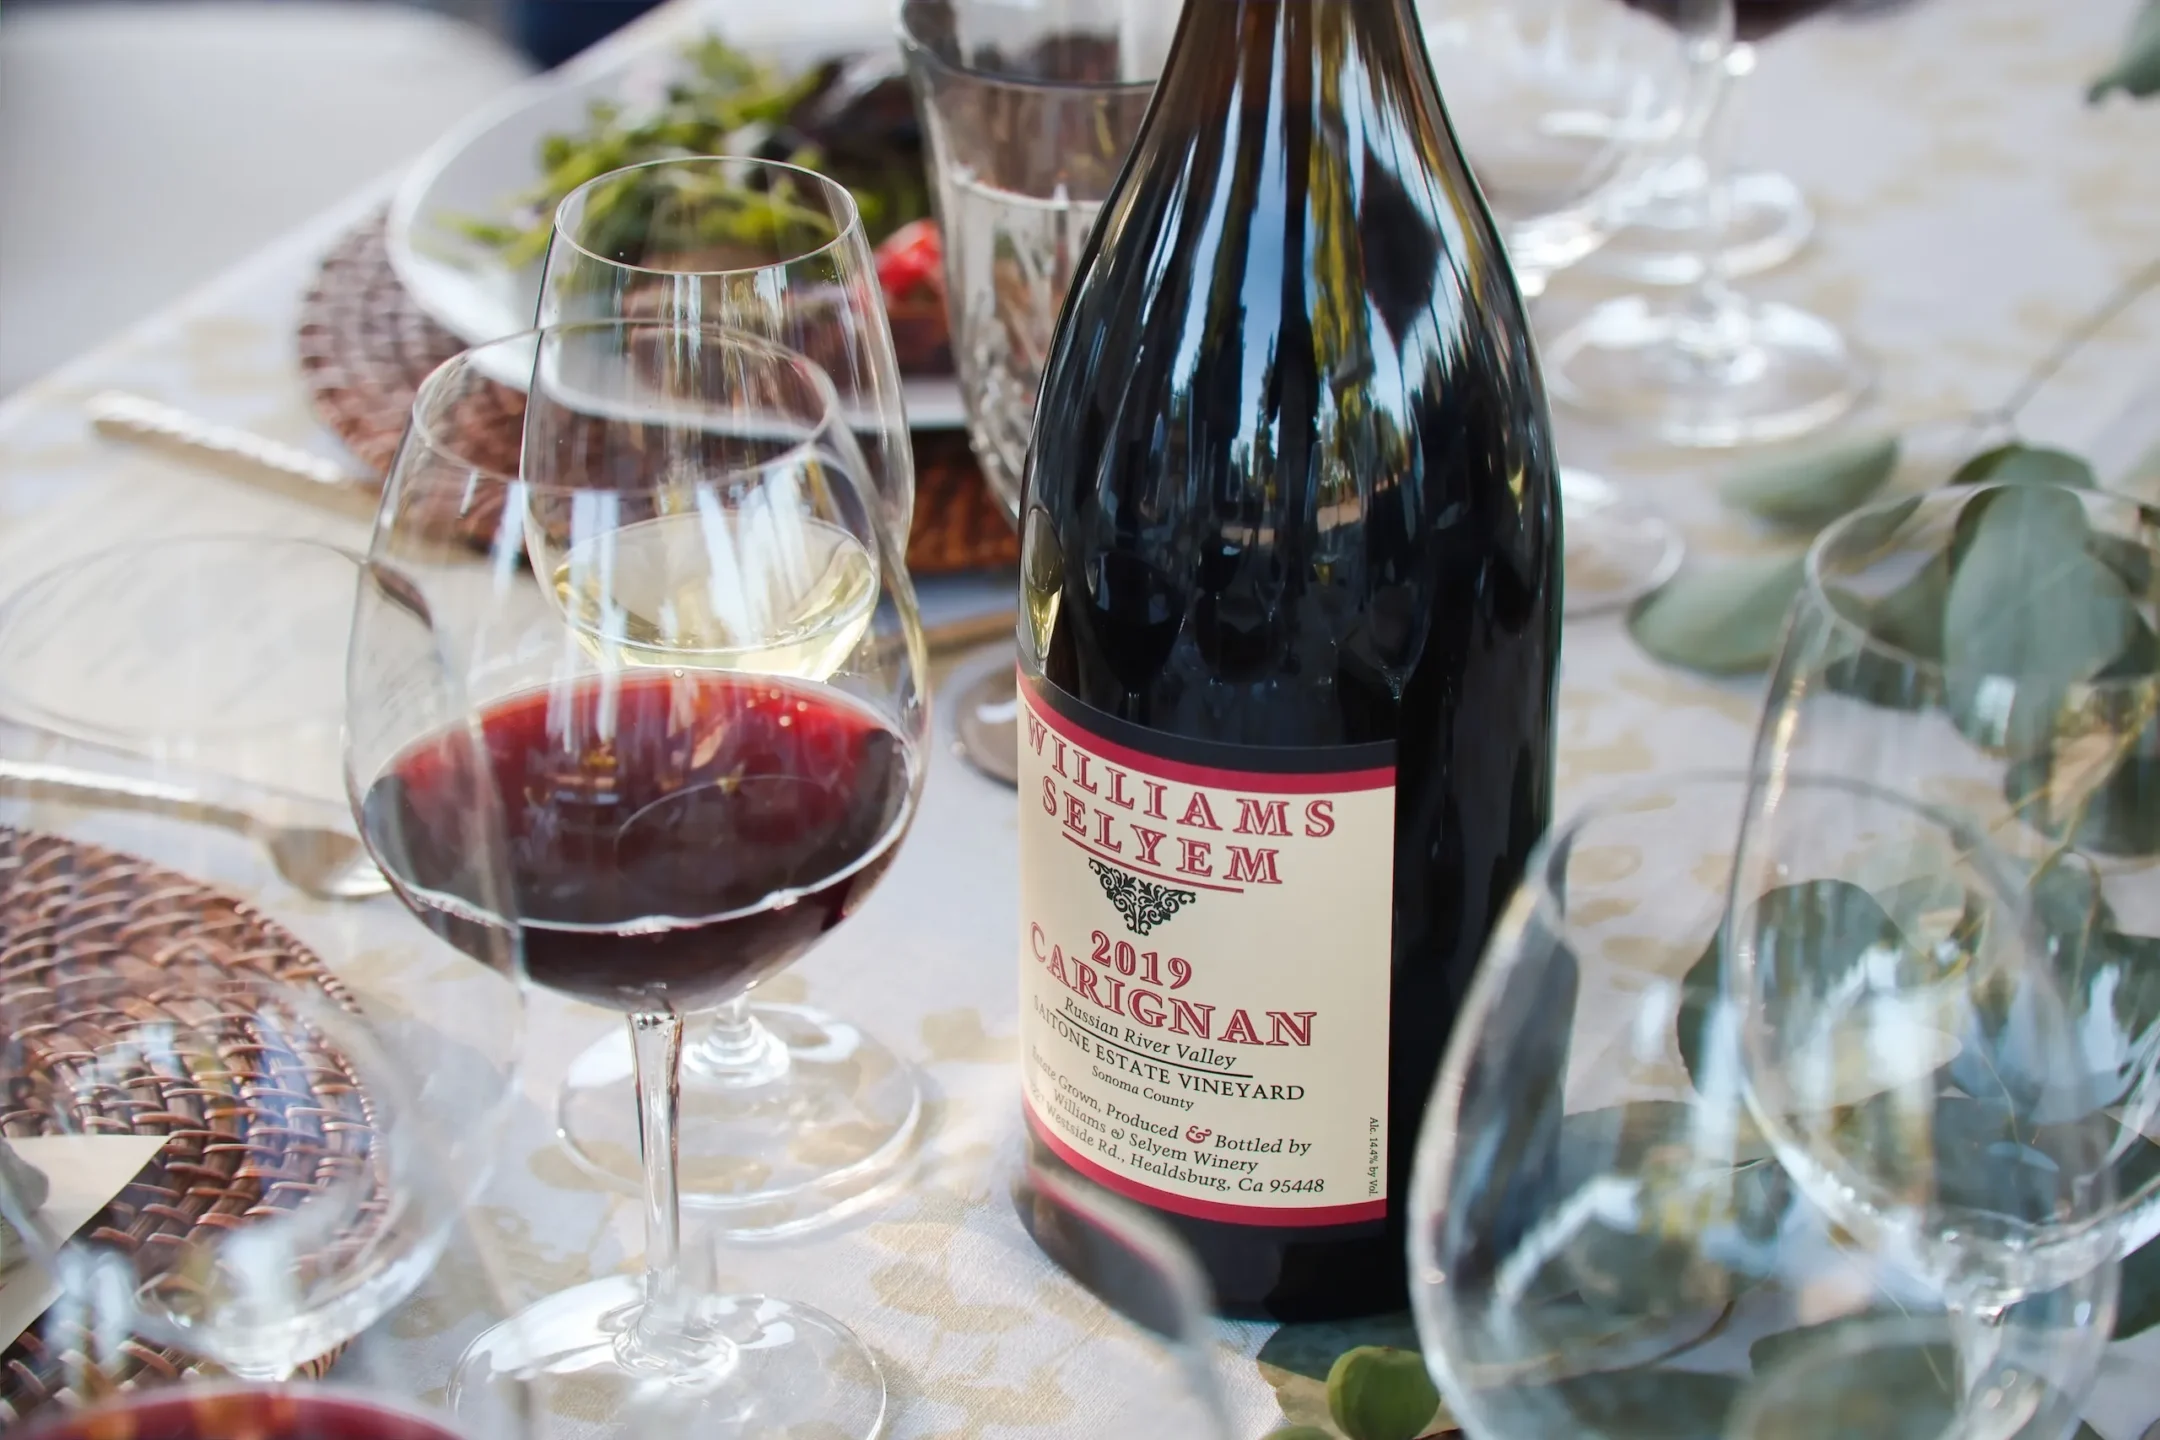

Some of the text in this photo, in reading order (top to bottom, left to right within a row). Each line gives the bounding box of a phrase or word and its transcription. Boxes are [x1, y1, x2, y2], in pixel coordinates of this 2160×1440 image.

[1025, 704, 1335, 838] WILLIAMS
[1042, 776, 1283, 885] SELYEM
[1030, 921, 1317, 1046] CARIGNAN
[1091, 930, 1192, 989] 2019
[1034, 994, 1305, 1101] SAITONE ESTATE VINEYARD
[1064, 996, 1237, 1070] Russian River Valley
[1054, 1088, 1106, 1134] Williams
[1111, 1127, 1125, 1141] &
[1129, 1133, 1188, 1162] Selyem
[1194, 1150, 1259, 1174] Winery
[1058, 1075, 1102, 1113] Grown,
[1106, 1103, 1179, 1140] Produced
[1185, 1125, 1212, 1144] &
[1214, 1134, 1284, 1153] Bottled
[1288, 1139, 1312, 1157] by
[1092, 1065, 1194, 1112] Sonoma County
[1046, 1101, 1325, 1193] Westside Rd., Healdsburg, Ca 95448
[1367, 1117, 1379, 1197] Alc. 14.4% by Vol.
